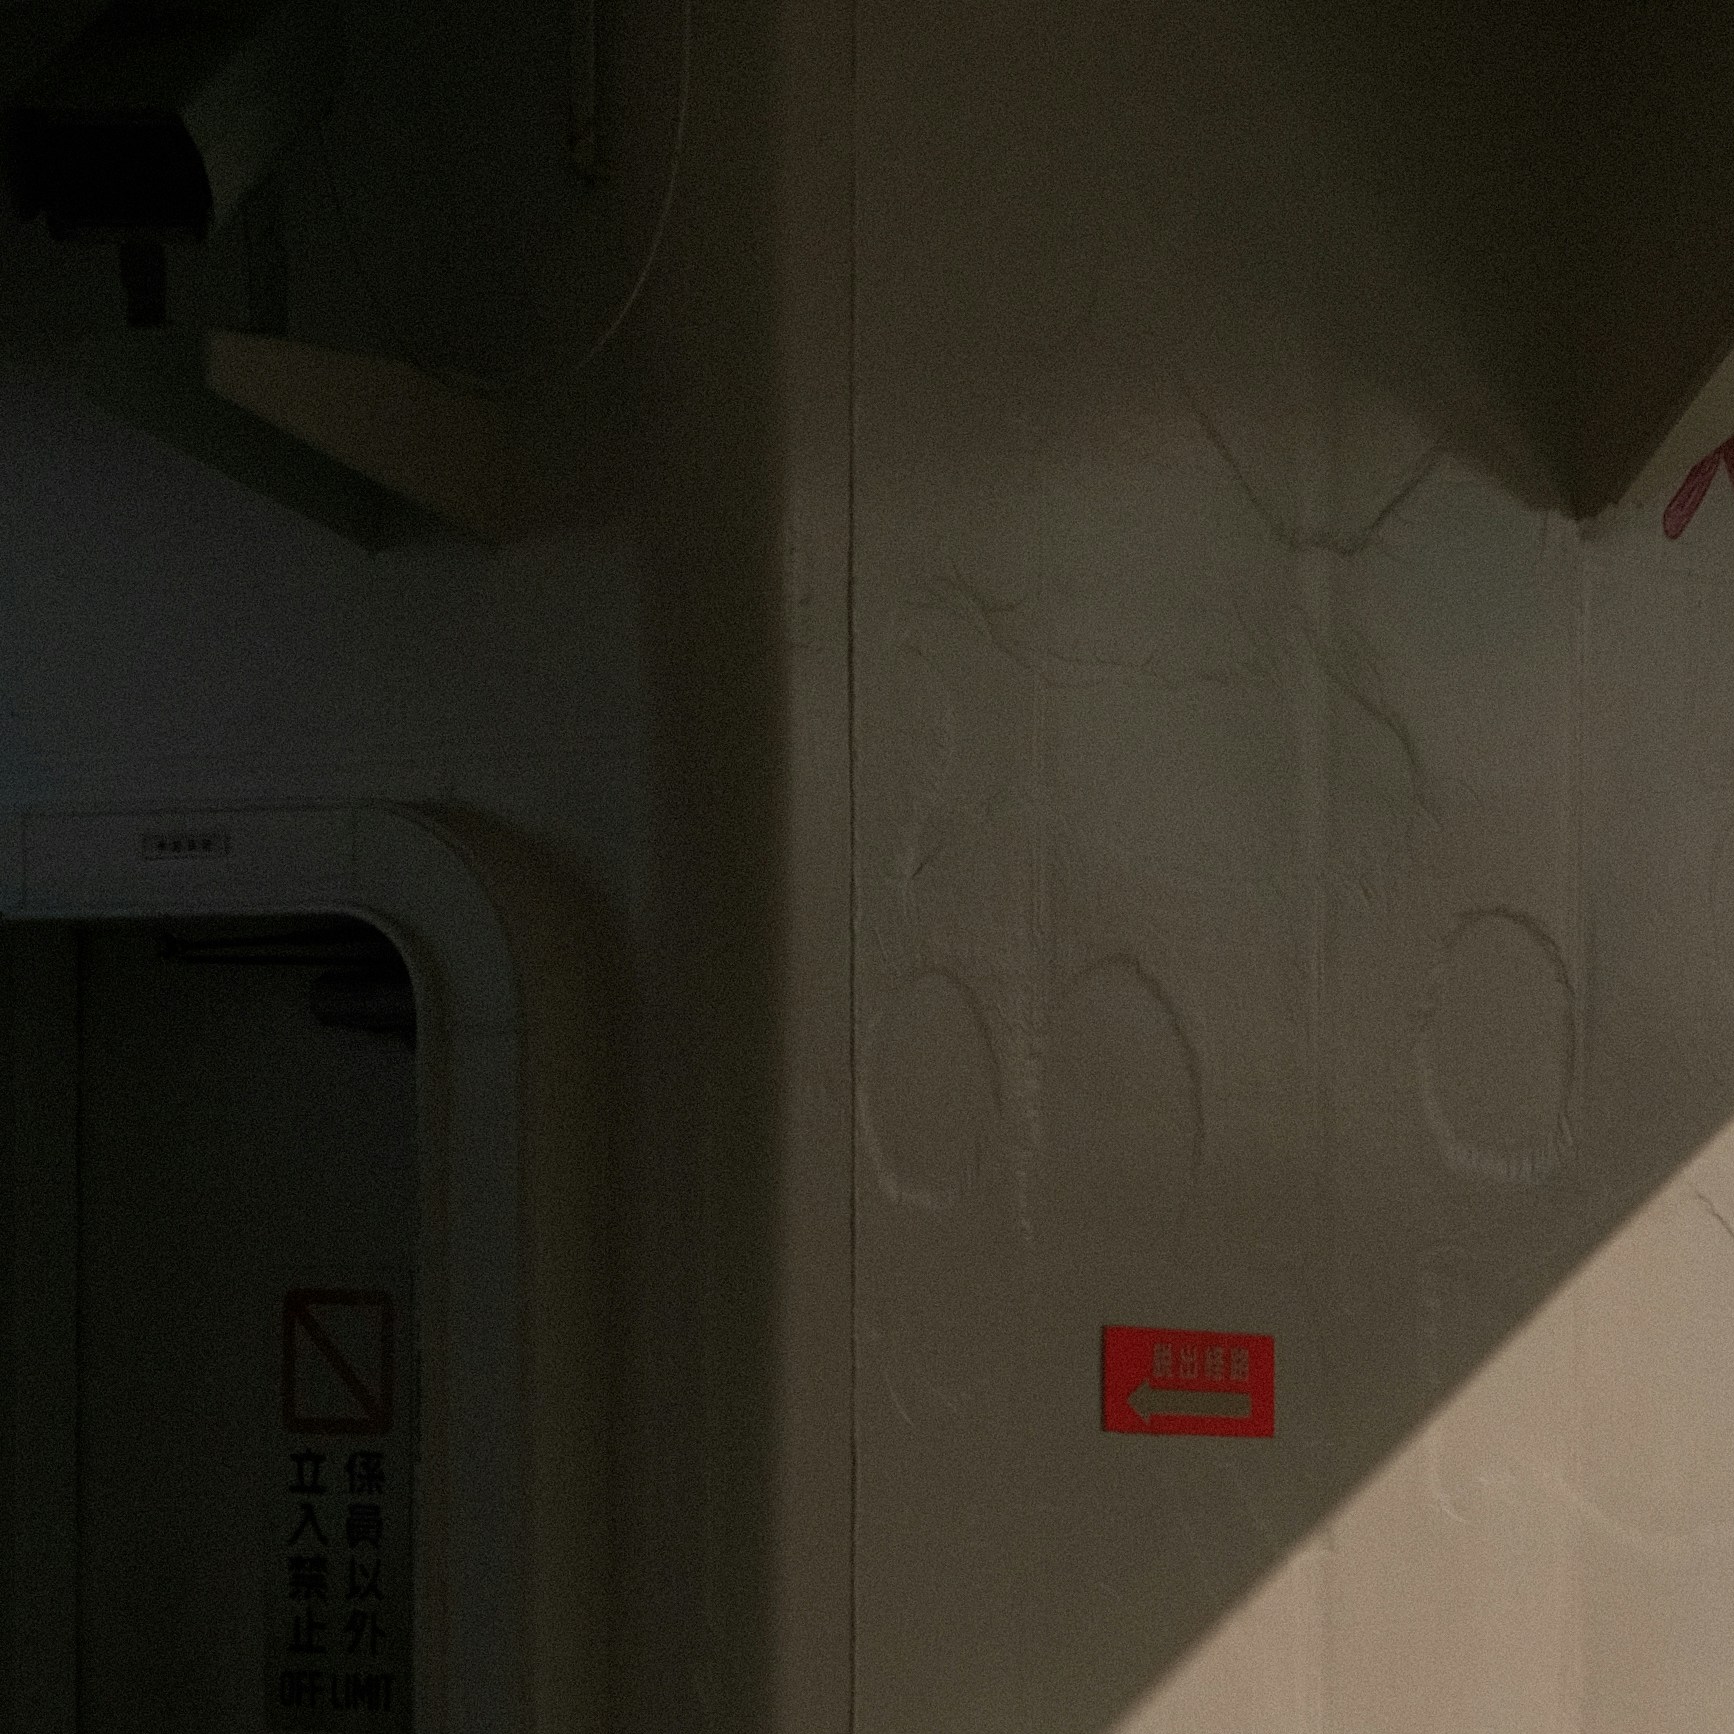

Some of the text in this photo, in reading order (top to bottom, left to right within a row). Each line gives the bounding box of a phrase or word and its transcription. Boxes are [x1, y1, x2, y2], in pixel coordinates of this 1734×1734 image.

[288, 1448, 328, 1653] 立入禁止
[343, 1451, 386, 1656] 係員以外
[279, 1671, 323, 1707] OFF
